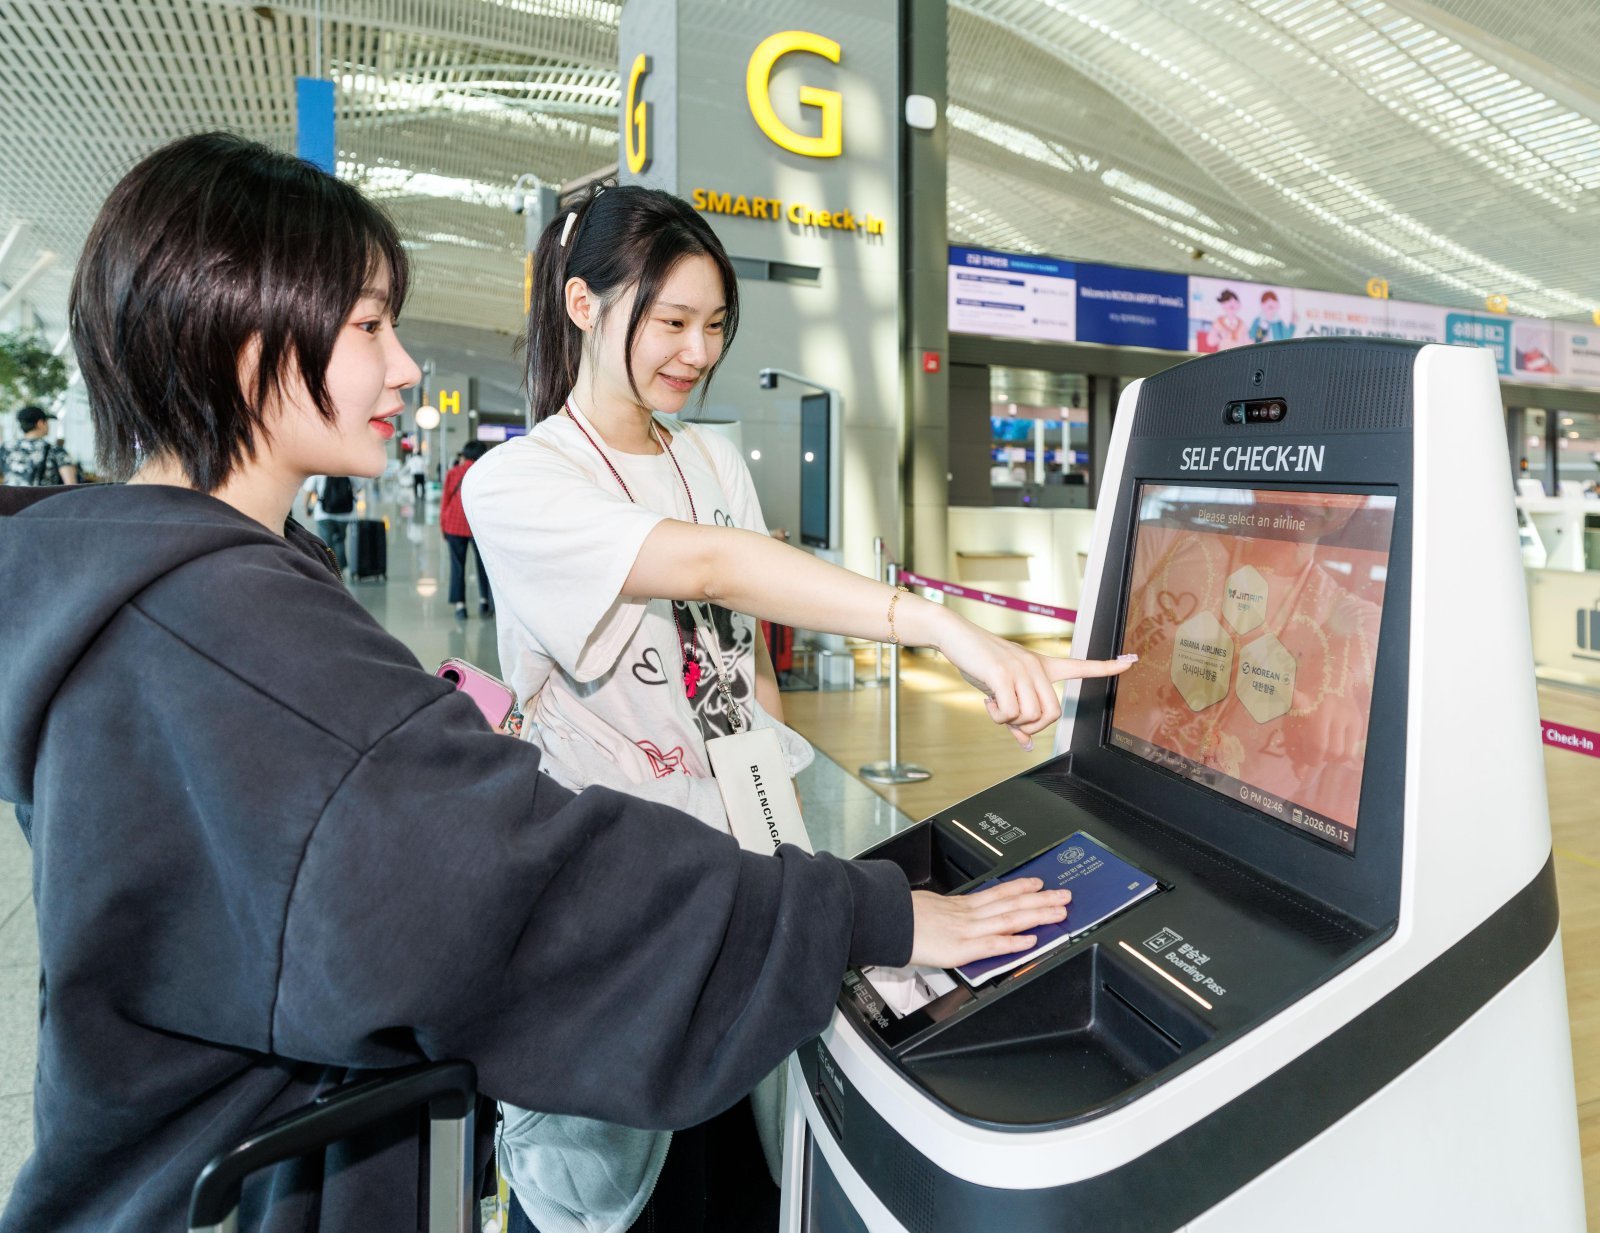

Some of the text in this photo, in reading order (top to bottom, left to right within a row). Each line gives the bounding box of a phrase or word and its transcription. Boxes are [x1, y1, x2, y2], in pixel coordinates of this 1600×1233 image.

[746, 30, 842, 158] G
[626, 53, 647, 174] G
[692, 188, 782, 220] SMART
[440, 390, 460, 414] H
[1180, 445, 1325, 472] SELF CHECK-IN
[1199, 509, 1306, 531] Please select an airline
[1180, 639, 1227, 658] ASIANA AIRLINES
[1182, 663, 1217, 682] 아시아나항공
[1252, 666, 1280, 681] KOREAN
[1252, 680, 1275, 696] 대한항공
[750, 764, 782, 848] BALENCIAGA
[1250, 791, 1349, 842] PM 02:46 2026.05.15
[1177, 943, 1211, 966] 탑승권
[1165, 951, 1226, 996] Boarding Pass
[865, 1001, 889, 1029] Barcode
